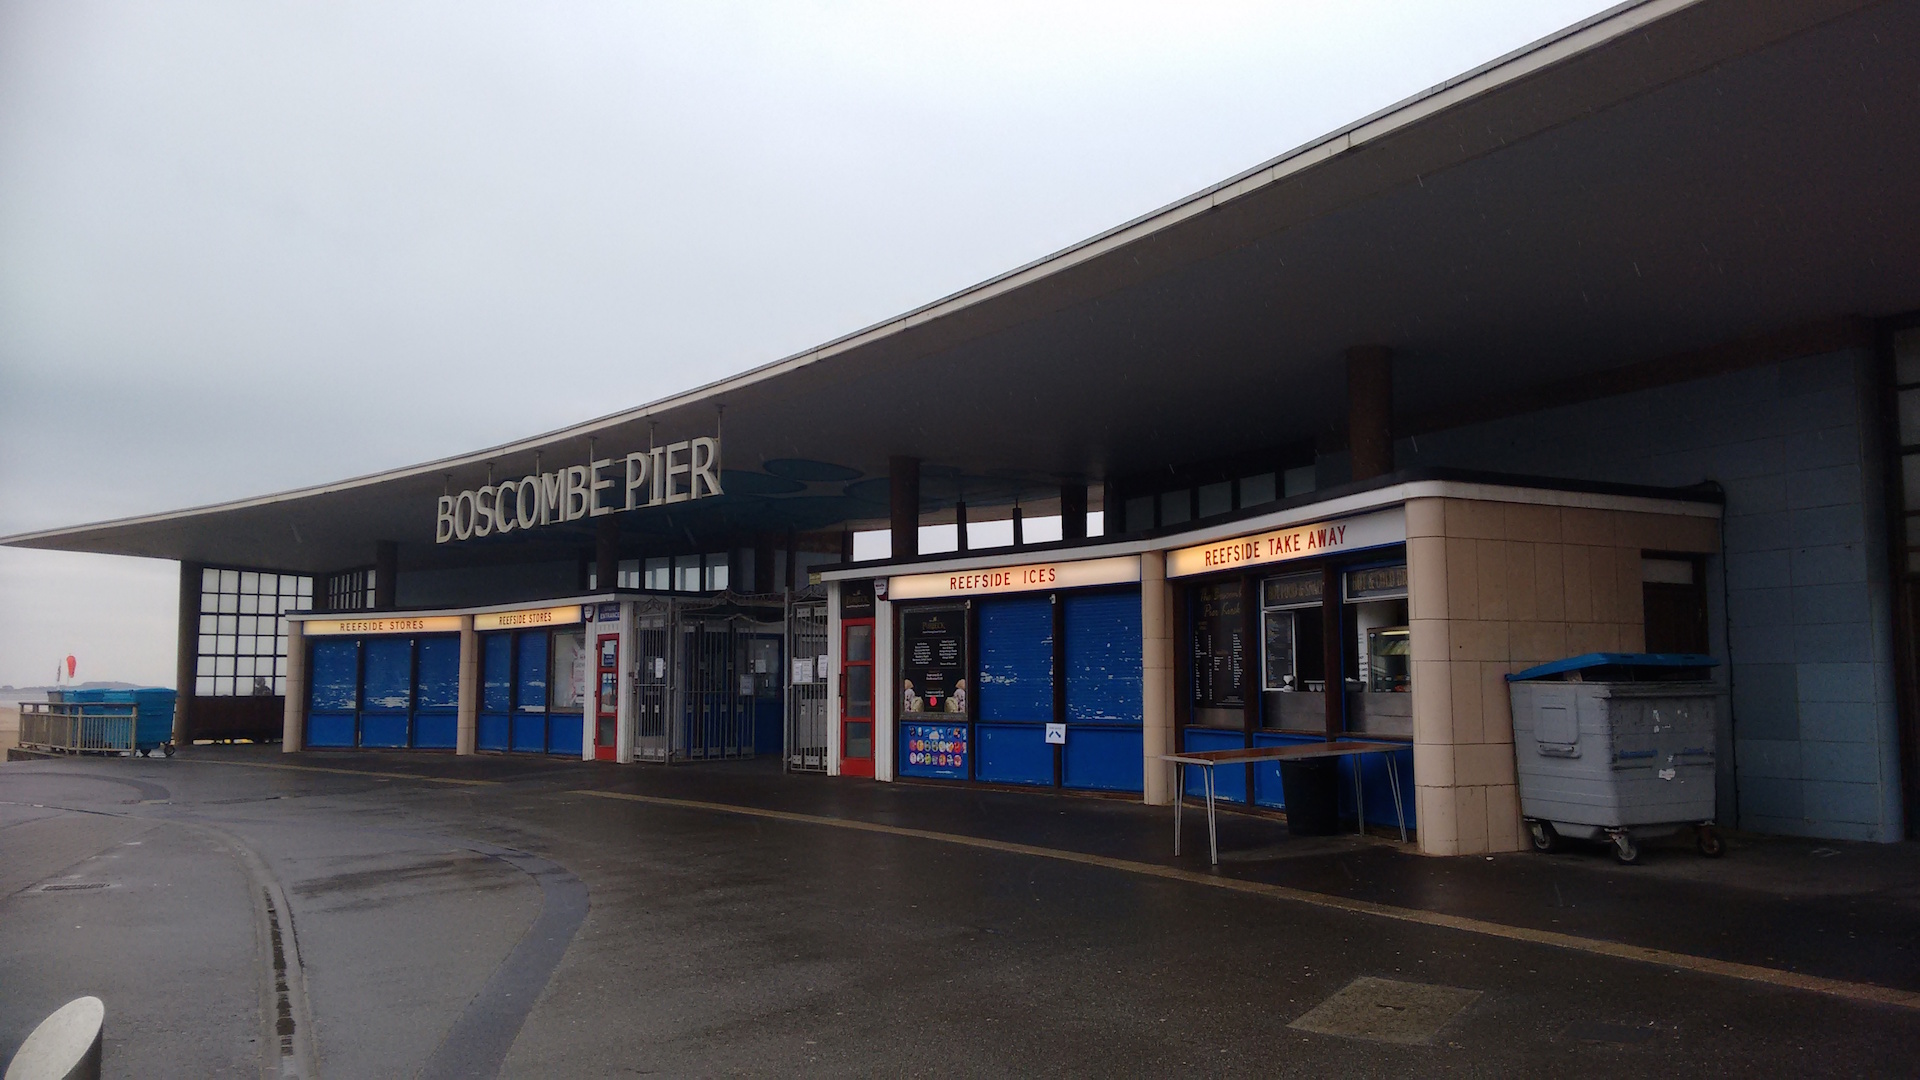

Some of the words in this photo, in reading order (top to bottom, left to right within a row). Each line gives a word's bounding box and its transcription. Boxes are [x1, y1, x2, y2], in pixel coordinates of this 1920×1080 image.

[435, 457, 616, 544] BOSCOMBE
[625, 436, 725, 511] PIER
[1205, 540, 1260, 567] REEFSIDE
[1268, 533, 1301, 556] TAKE
[1307, 525, 1346, 549] AWAY
[950, 571, 1011, 590] REEFSIDE
[1023, 568, 1056, 585] ICES
[340, 621, 384, 632] REEFSIDE
[389, 619, 424, 631] STORES
[499, 613, 527, 626] REEFSIDE
[528, 611, 552, 623] STORES
